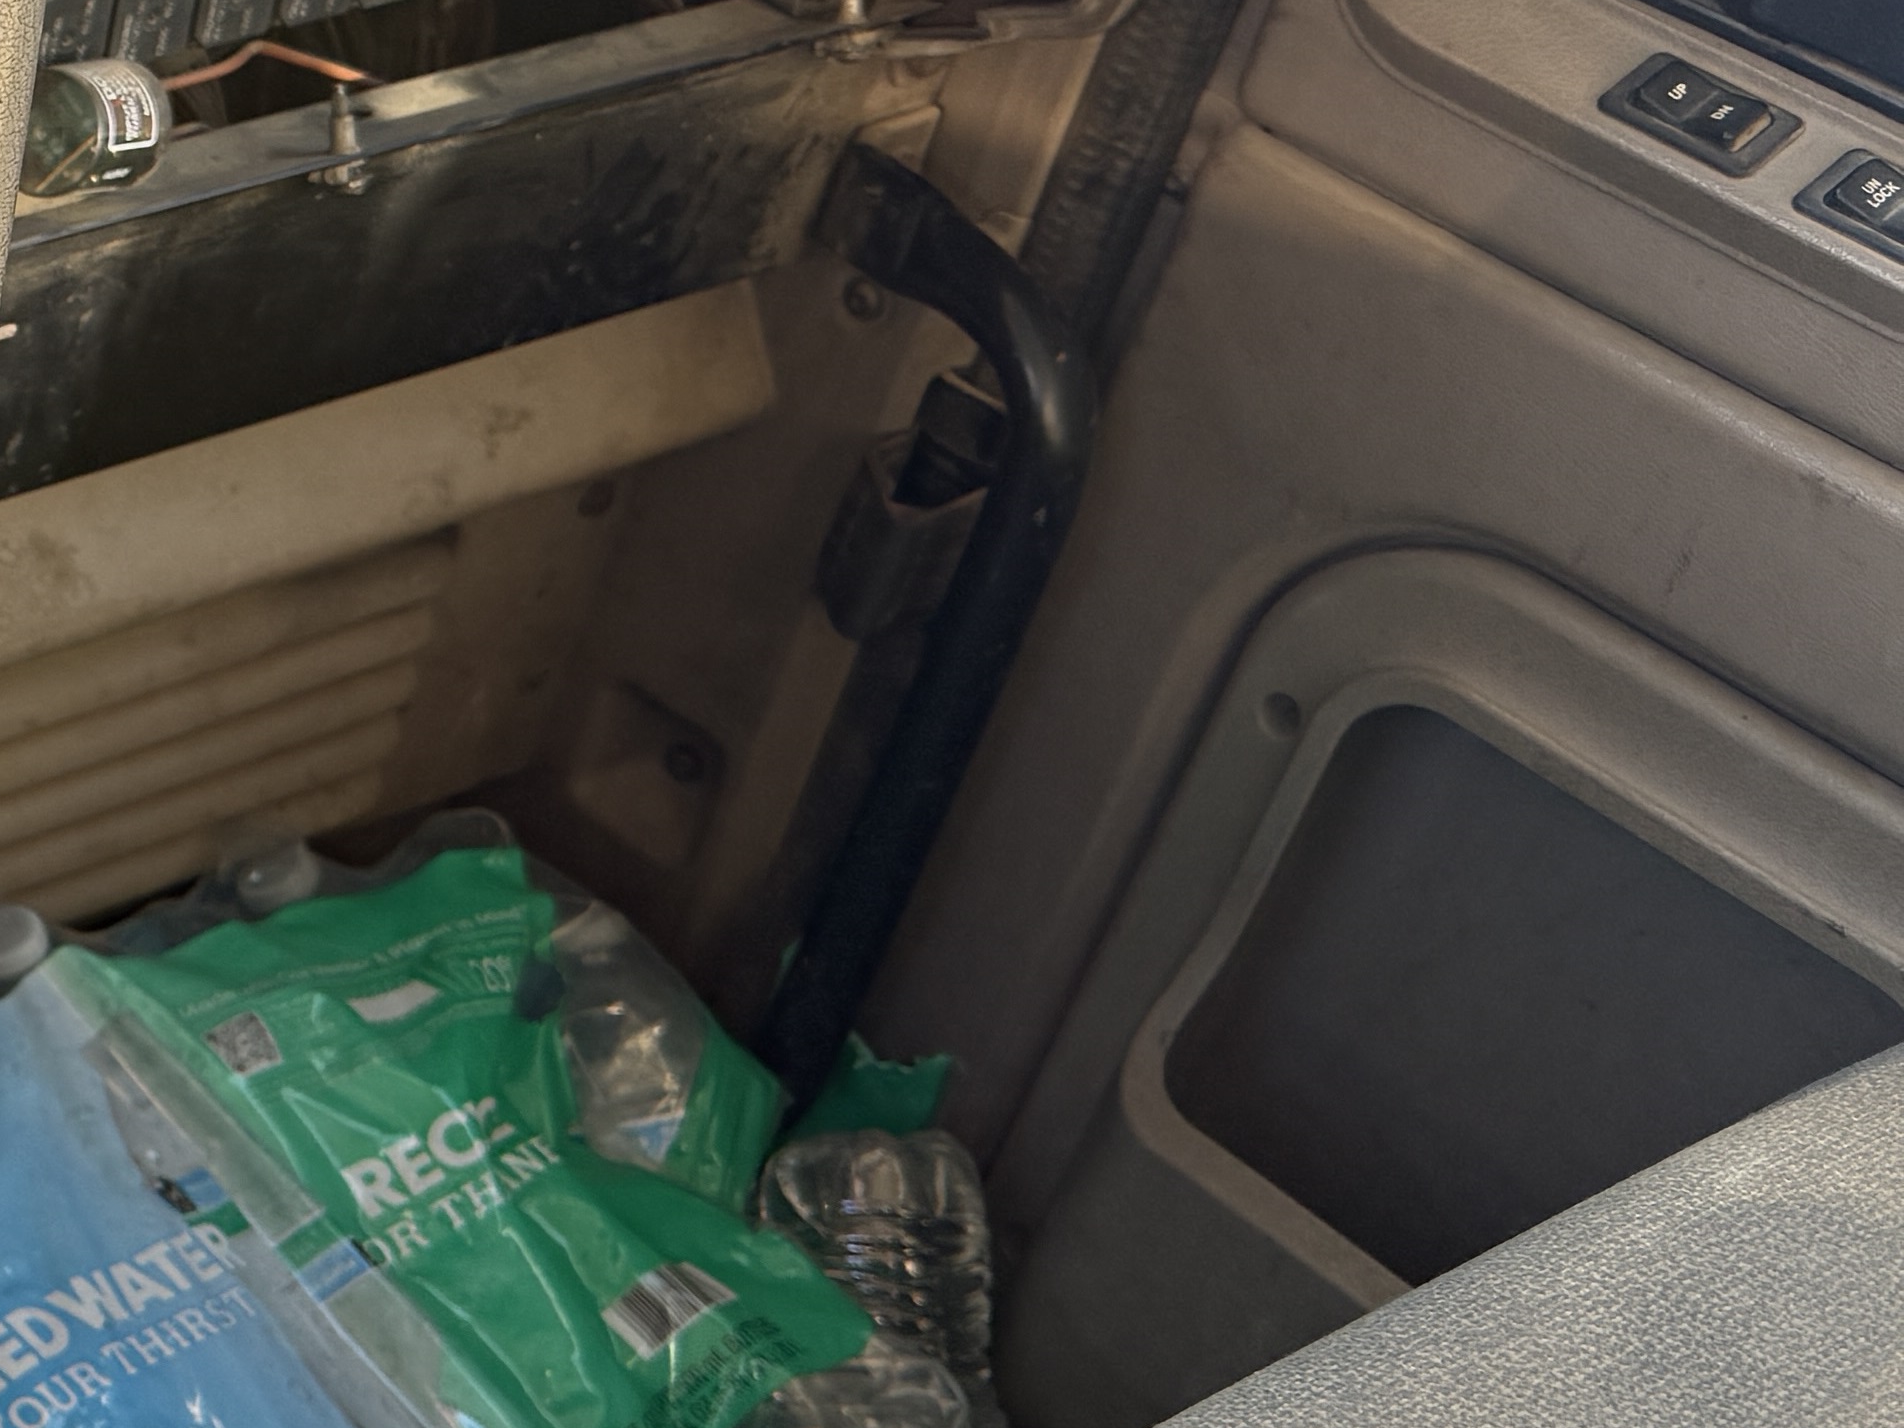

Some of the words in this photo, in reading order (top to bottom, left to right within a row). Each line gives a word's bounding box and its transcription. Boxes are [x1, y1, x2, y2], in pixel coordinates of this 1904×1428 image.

[1668, 82, 1688, 101] UP
[1711, 104, 1735, 121] DN
[1862, 177, 1882, 195] UN
[1866, 182, 1900, 209] LOCK
[50, 1220, 248, 1331] WATER
[101, 1286, 259, 1376] THIRST
